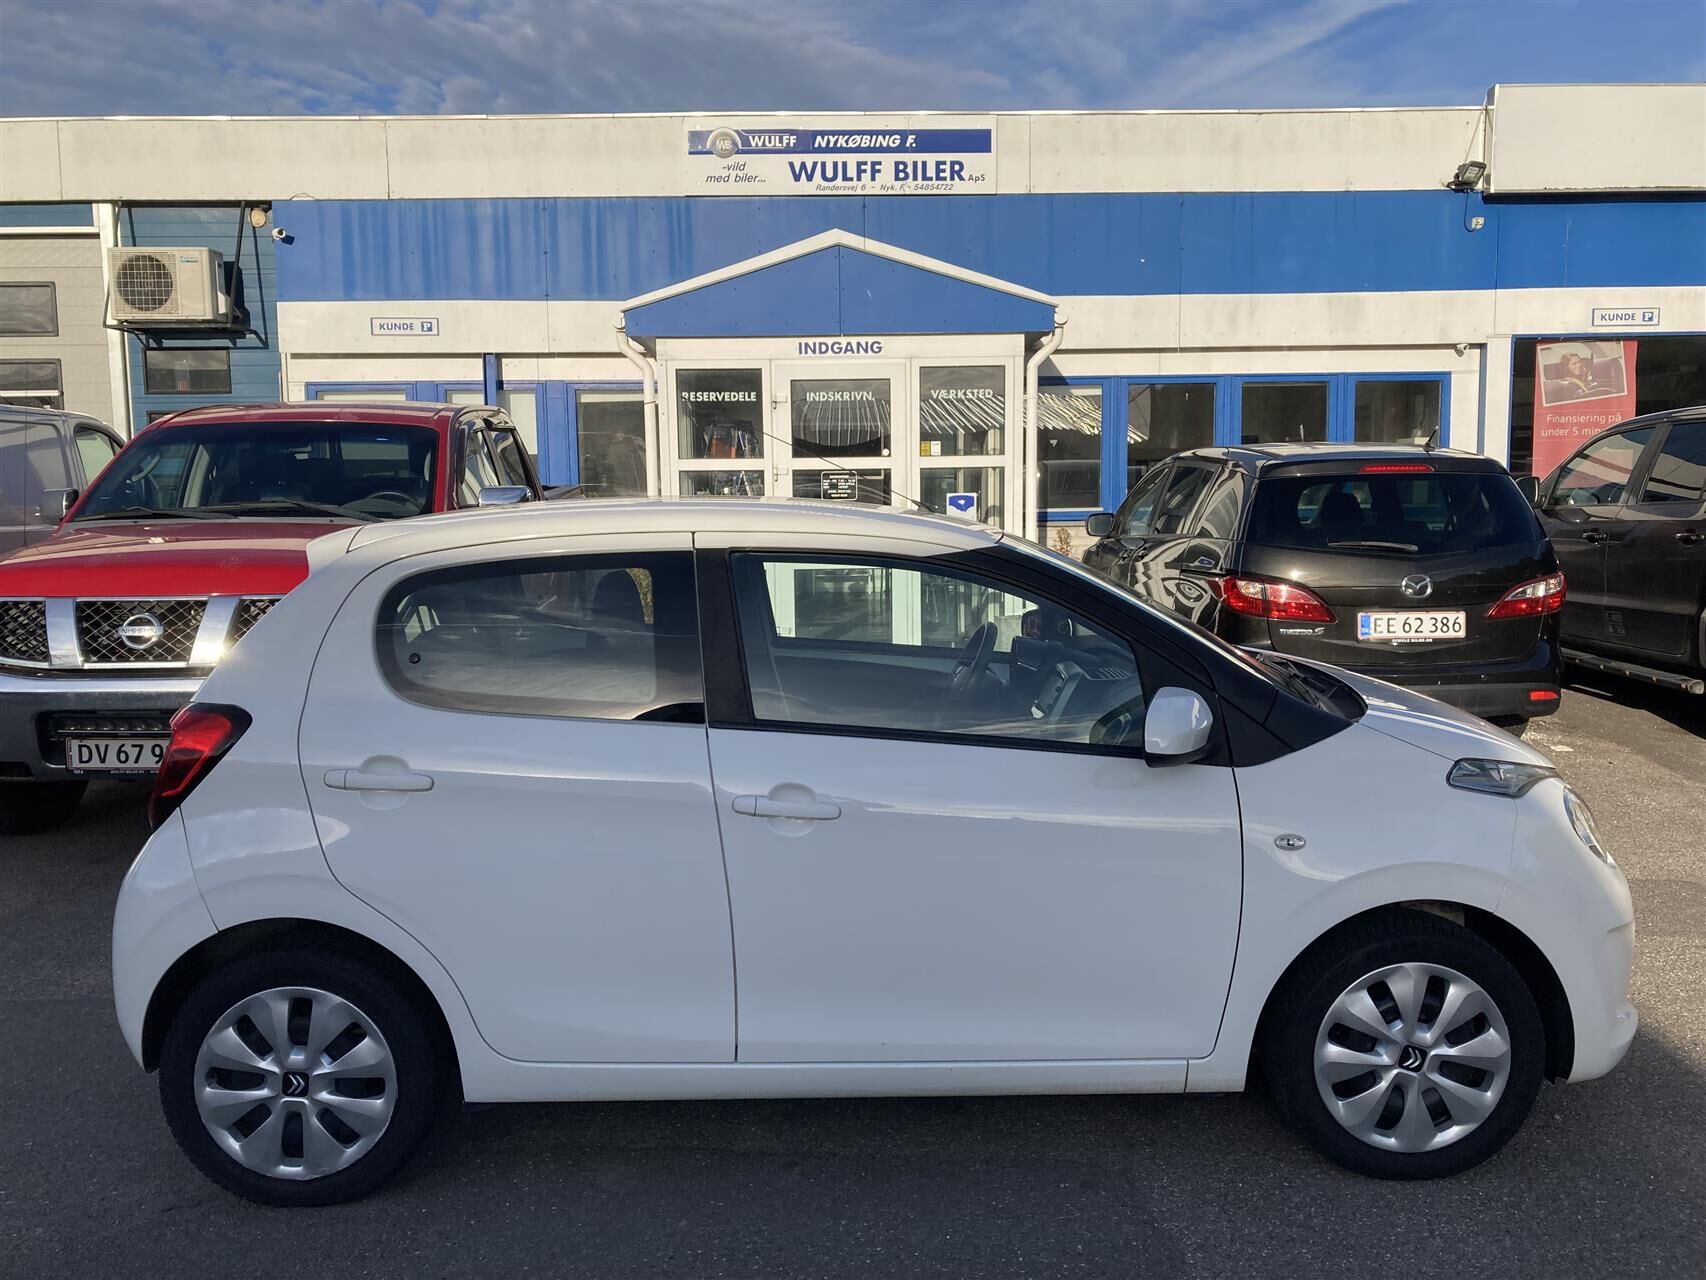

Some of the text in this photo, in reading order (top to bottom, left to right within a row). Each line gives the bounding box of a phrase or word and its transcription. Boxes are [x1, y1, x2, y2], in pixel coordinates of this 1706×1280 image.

[749, 135, 797, 148] WULFF
[814, 134, 917, 148] NYKØBING F.
[722, 161, 746, 172] -vild
[788, 160, 986, 183] WULFF BILER ApS
[705, 172, 766, 183] med biler...
[815, 183, 859, 192] Randersvej
[879, 184, 897, 192] Nyk.
[1600, 312, 1636, 321] KUNDE
[379, 322, 414, 331] KUNDE
[798, 340, 883, 355] INDGANG
[682, 391, 757, 401] RESERVEDELE
[806, 391, 875, 401] INDSKRIVN.
[931, 388, 993, 399] VÆRKSTED
[1547, 412, 1622, 424] Finansiering på
[1541, 427, 1569, 437] under
[1572, 427, 1579, 436] 5
[1374, 616, 1462, 634] EE 62 386
[78, 744, 109, 764] DV
[116, 744, 144, 764] 67
